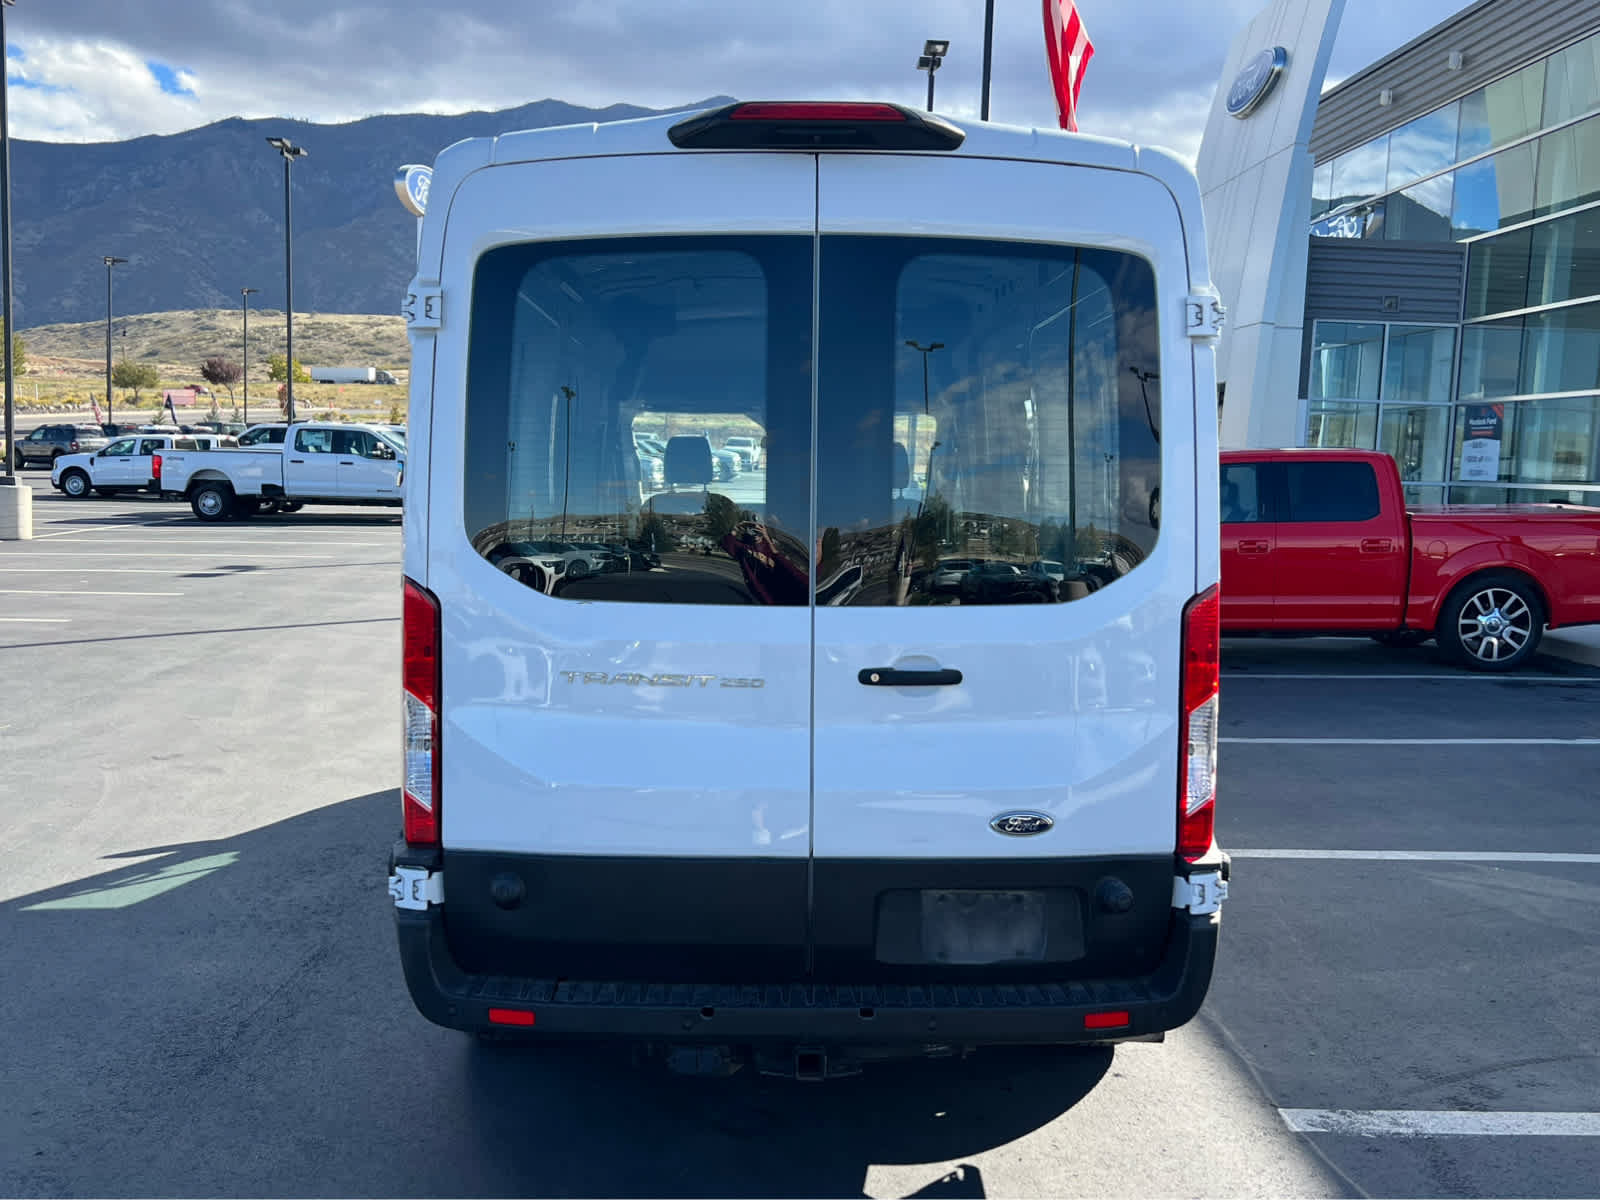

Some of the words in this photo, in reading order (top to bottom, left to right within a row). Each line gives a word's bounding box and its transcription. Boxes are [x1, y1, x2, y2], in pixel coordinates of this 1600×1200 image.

[560, 671, 716, 688] TRANSIT
[720, 678, 765, 689] 250
[1004, 816, 1041, 832] Ford
